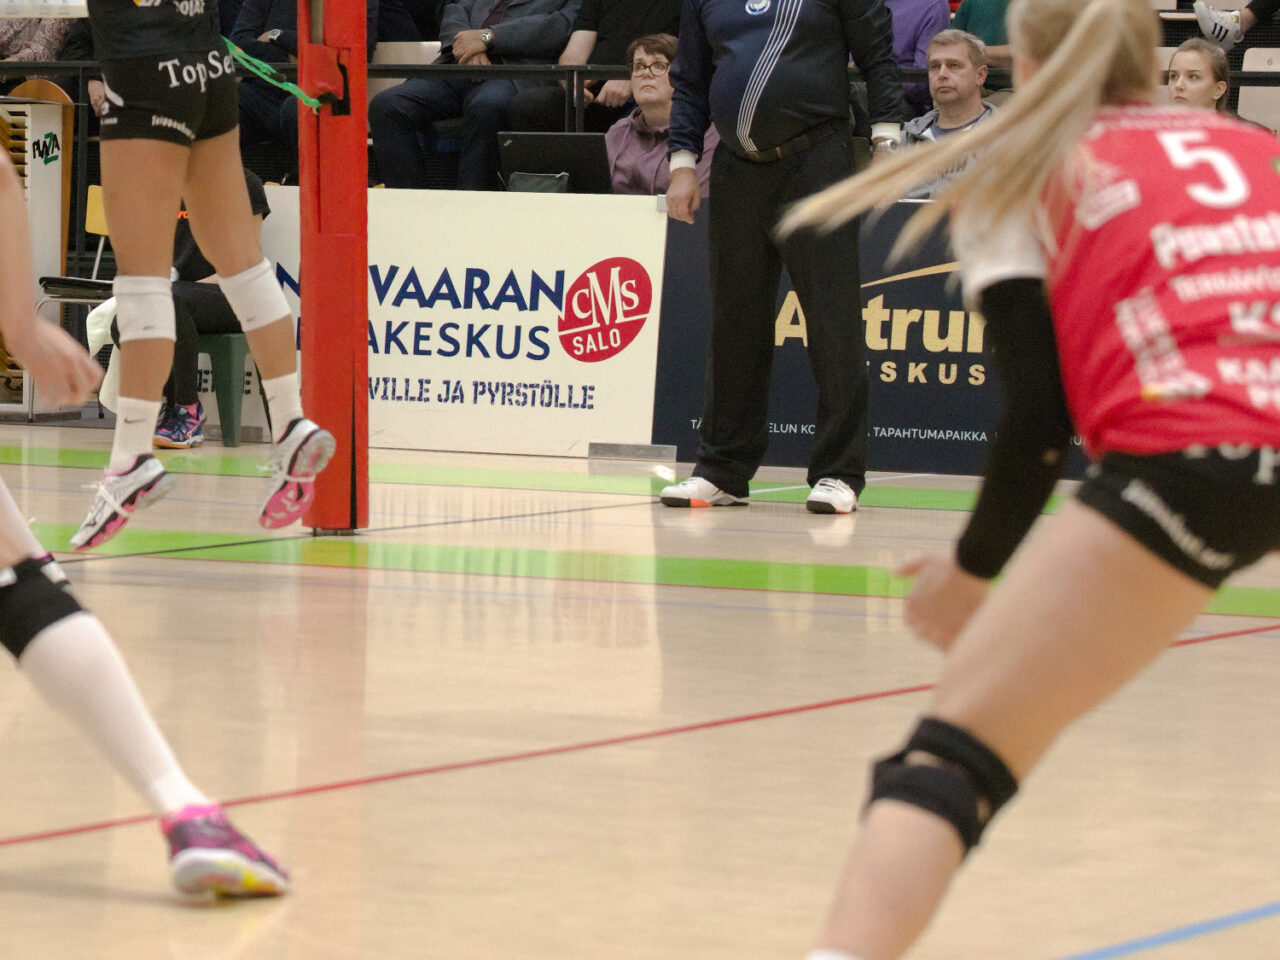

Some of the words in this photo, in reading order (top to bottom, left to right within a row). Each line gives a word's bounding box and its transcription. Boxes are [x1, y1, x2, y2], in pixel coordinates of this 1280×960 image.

[1156, 130, 1251, 210] 5
[572, 328, 622, 356] SALO
[437, 379, 465, 405] JA
[472, 379, 596, 410] PYRSTÖLLE
[873, 426, 988, 442] TAPAHTUMAPAIKKA
